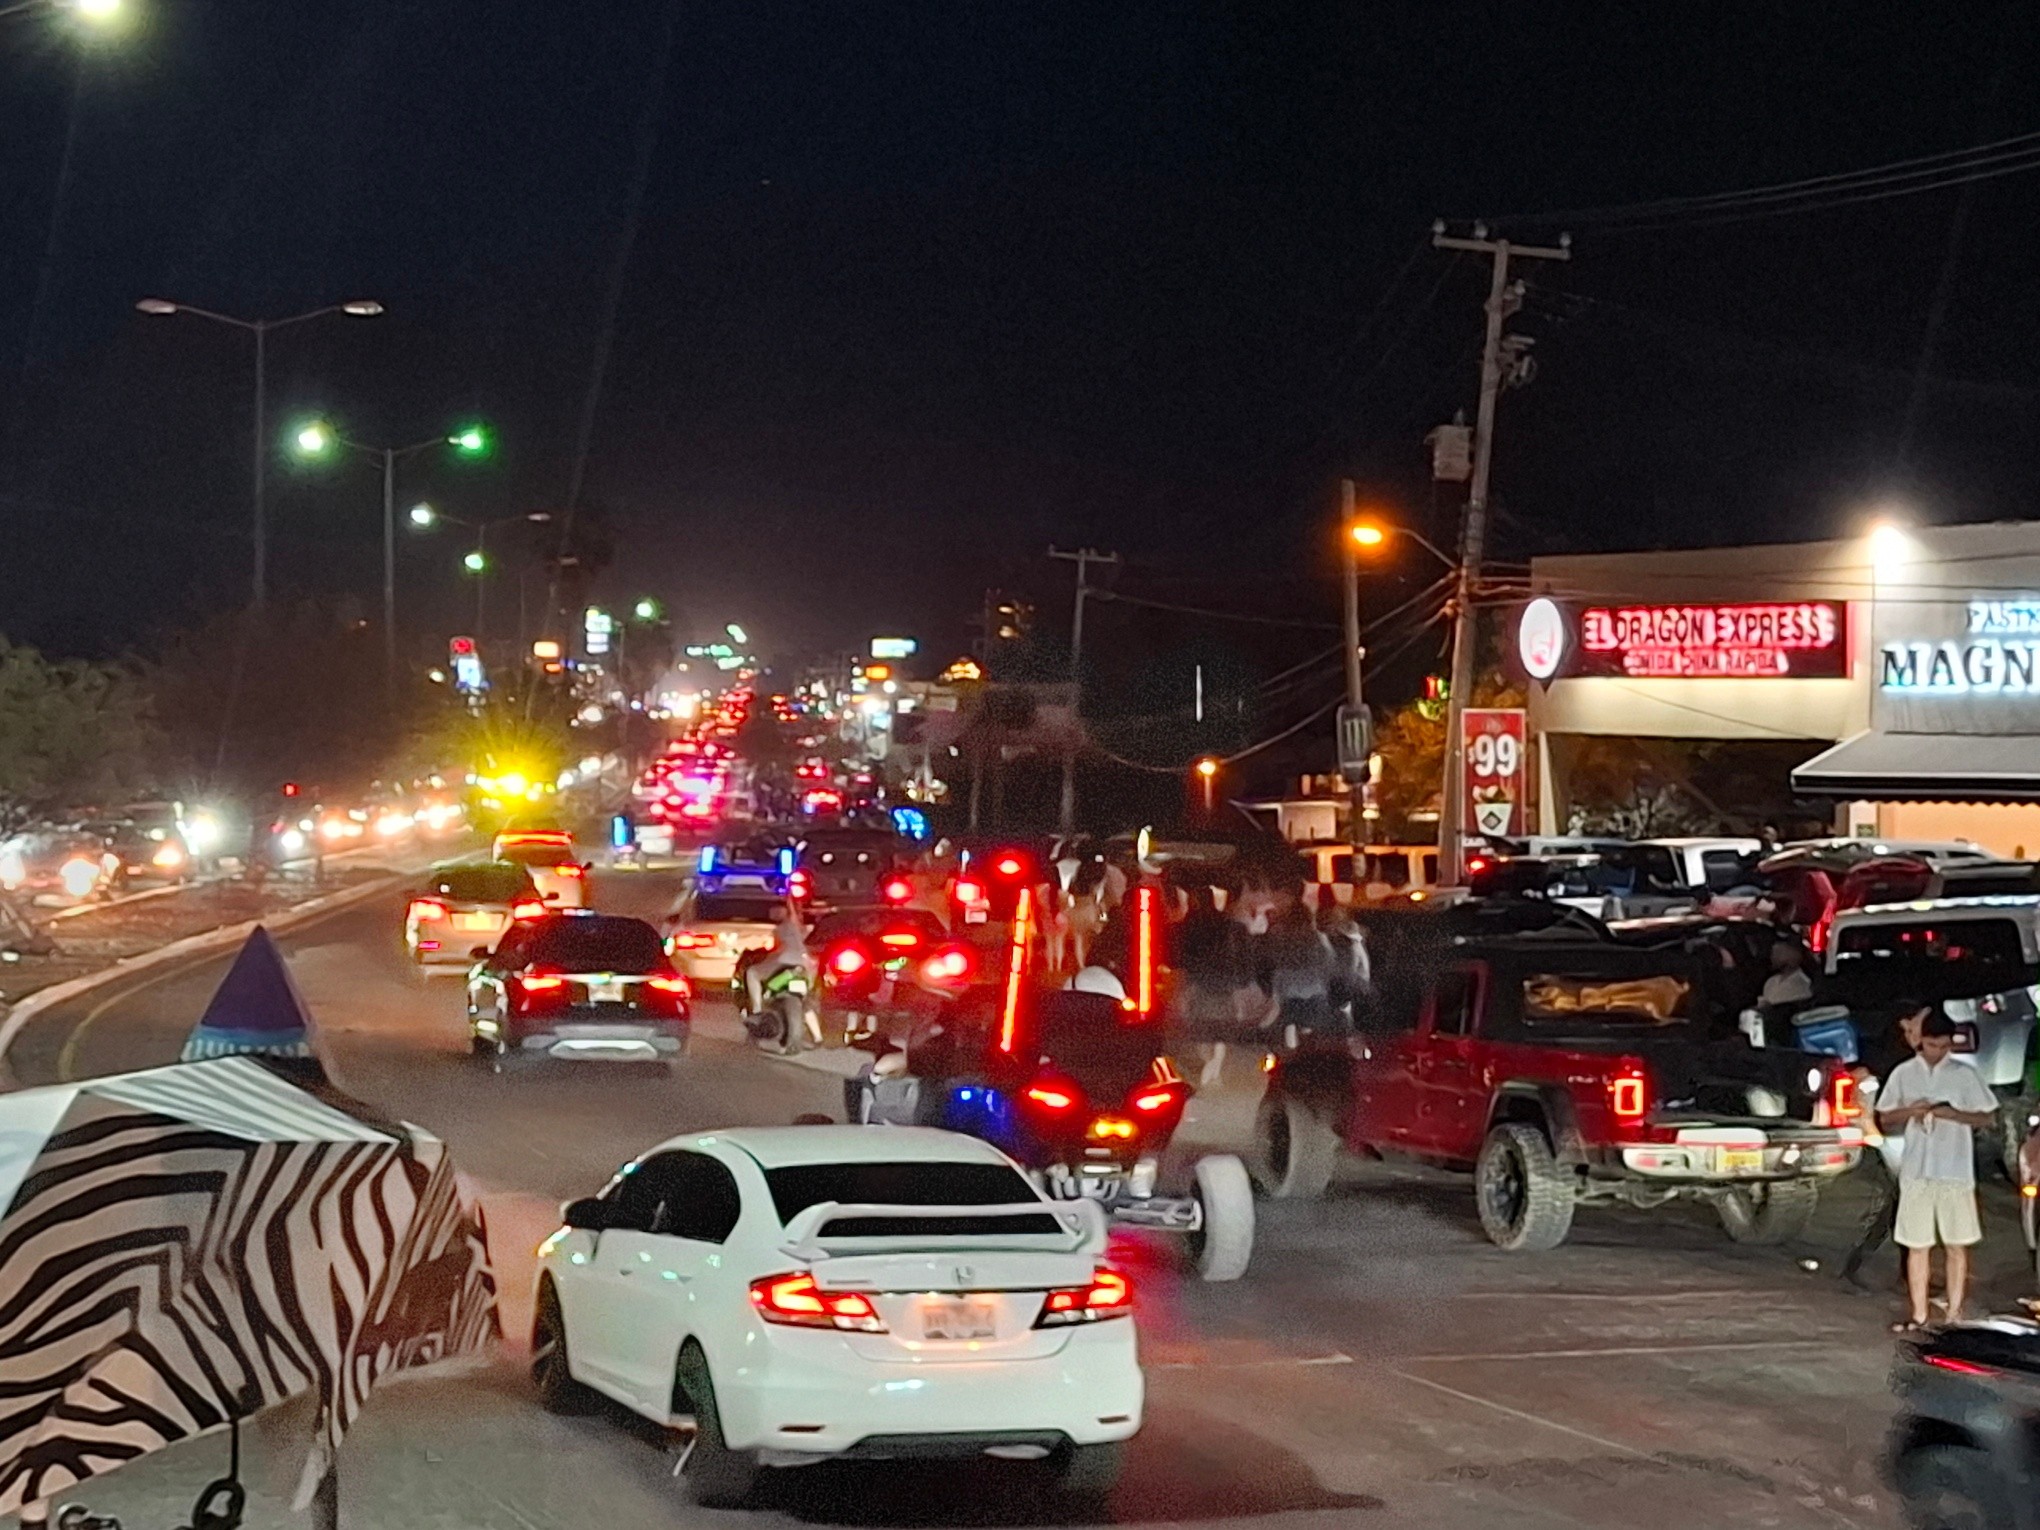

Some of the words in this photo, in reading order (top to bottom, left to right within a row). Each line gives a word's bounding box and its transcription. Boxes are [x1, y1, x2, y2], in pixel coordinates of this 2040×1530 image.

[1584, 612, 1610, 648] EL
[1614, 609, 1707, 646] DRAGON
[1714, 606, 1826, 645] EXPRESS
